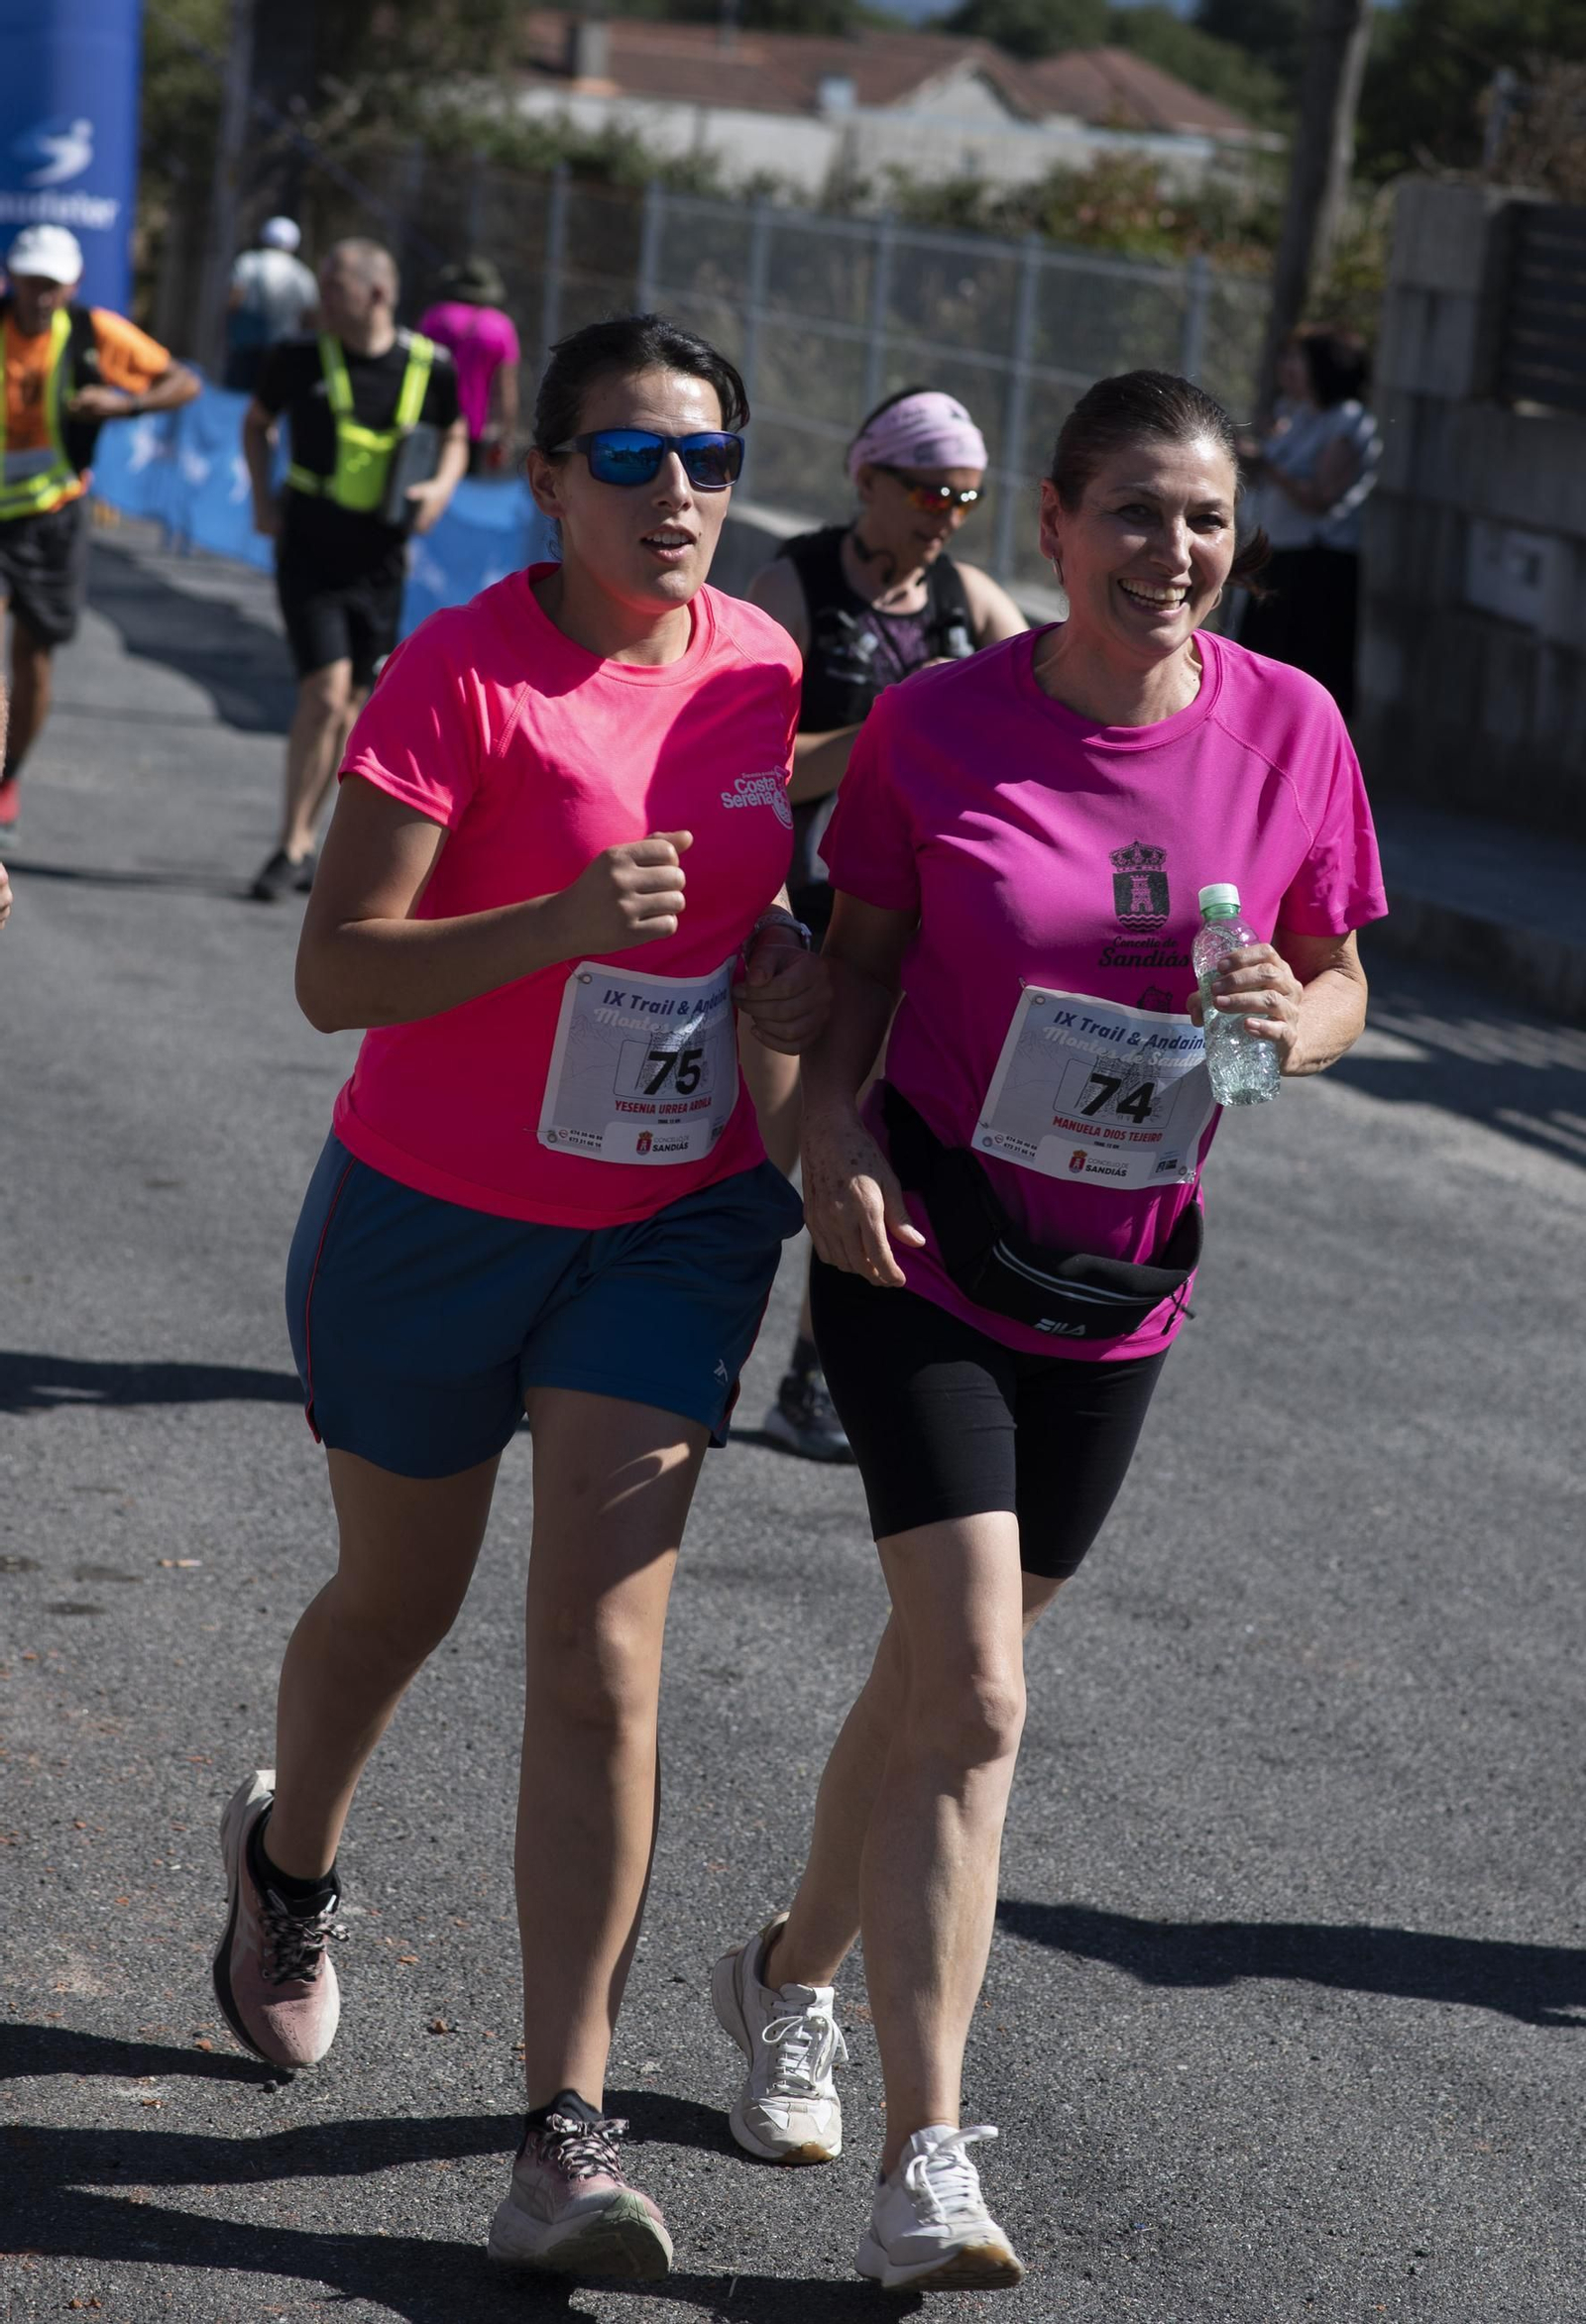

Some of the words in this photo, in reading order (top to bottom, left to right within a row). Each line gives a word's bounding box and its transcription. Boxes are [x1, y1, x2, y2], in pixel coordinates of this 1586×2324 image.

[735, 777, 775, 794] Costa
[721, 792, 773, 809] Serena
[1113, 936, 1159, 947] Concello
[1162, 938, 1178, 947] de
[1098, 946, 1190, 967] Sandiás
[603, 989, 626, 1007] IX
[630, 994, 676, 1016] Trail
[677, 1000, 690, 1016] &
[594, 1007, 669, 1034] Montes
[1053, 1011, 1077, 1028] IX
[1080, 1018, 1125, 1041] Trail
[1126, 1031, 1142, 1047] &
[1042, 1027, 1118, 1059] Montes
[1123, 1047, 1143, 1065] de
[642, 1048, 704, 1096] 75
[615, 1099, 656, 1115] YESENIA
[658, 1101, 688, 1115] URREA
[1081, 1072, 1155, 1123] 74
[1053, 1115, 1100, 1137] MANUELA
[1103, 1125, 1126, 1141] DIOS
[1129, 1132, 1163, 1143] TEJEIRO
[652, 1142, 689, 1152] SANDIÁS
[1085, 1164, 1128, 1176] SANDIÁS
[1087, 1158, 1120, 1167] CONCELLO
[1035, 1318, 1086, 1336] FILA
